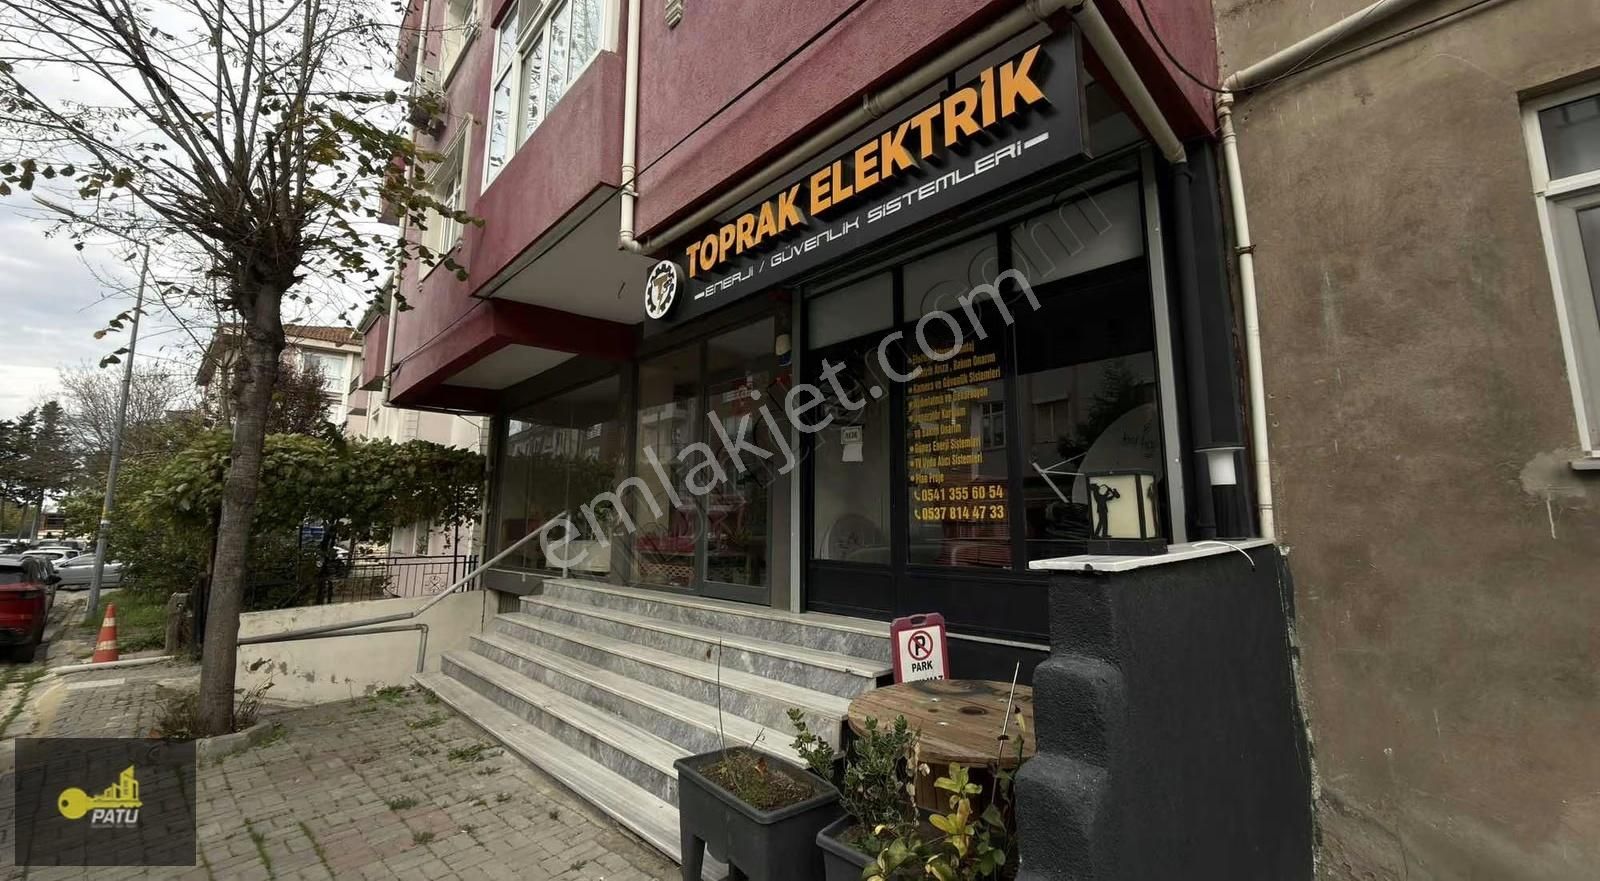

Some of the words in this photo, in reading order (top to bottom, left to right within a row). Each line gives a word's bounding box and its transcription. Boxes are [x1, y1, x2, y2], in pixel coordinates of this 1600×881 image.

[686, 183, 801, 279] TOPRAK
[810, 44, 1046, 216] ELEKTRİK
[969, 366, 1001, 383] Sistemleri
[950, 436, 982, 450] Sistemleri
[915, 457, 923, 468] TV
[951, 451, 983, 465] Sistemleri
[915, 473, 929, 484] Plan
[929, 473, 945, 484] Proje
[921, 488, 945, 501] 0541
[949, 487, 969, 501] 355
[972, 486, 986, 499] 60
[989, 485, 1003, 499] 54
[922, 506, 947, 520] 0537
[949, 506, 969, 519] 814
[972, 505, 986, 519] 47
[990, 505, 1004, 519] 33
[912, 661, 933, 672] PARK
